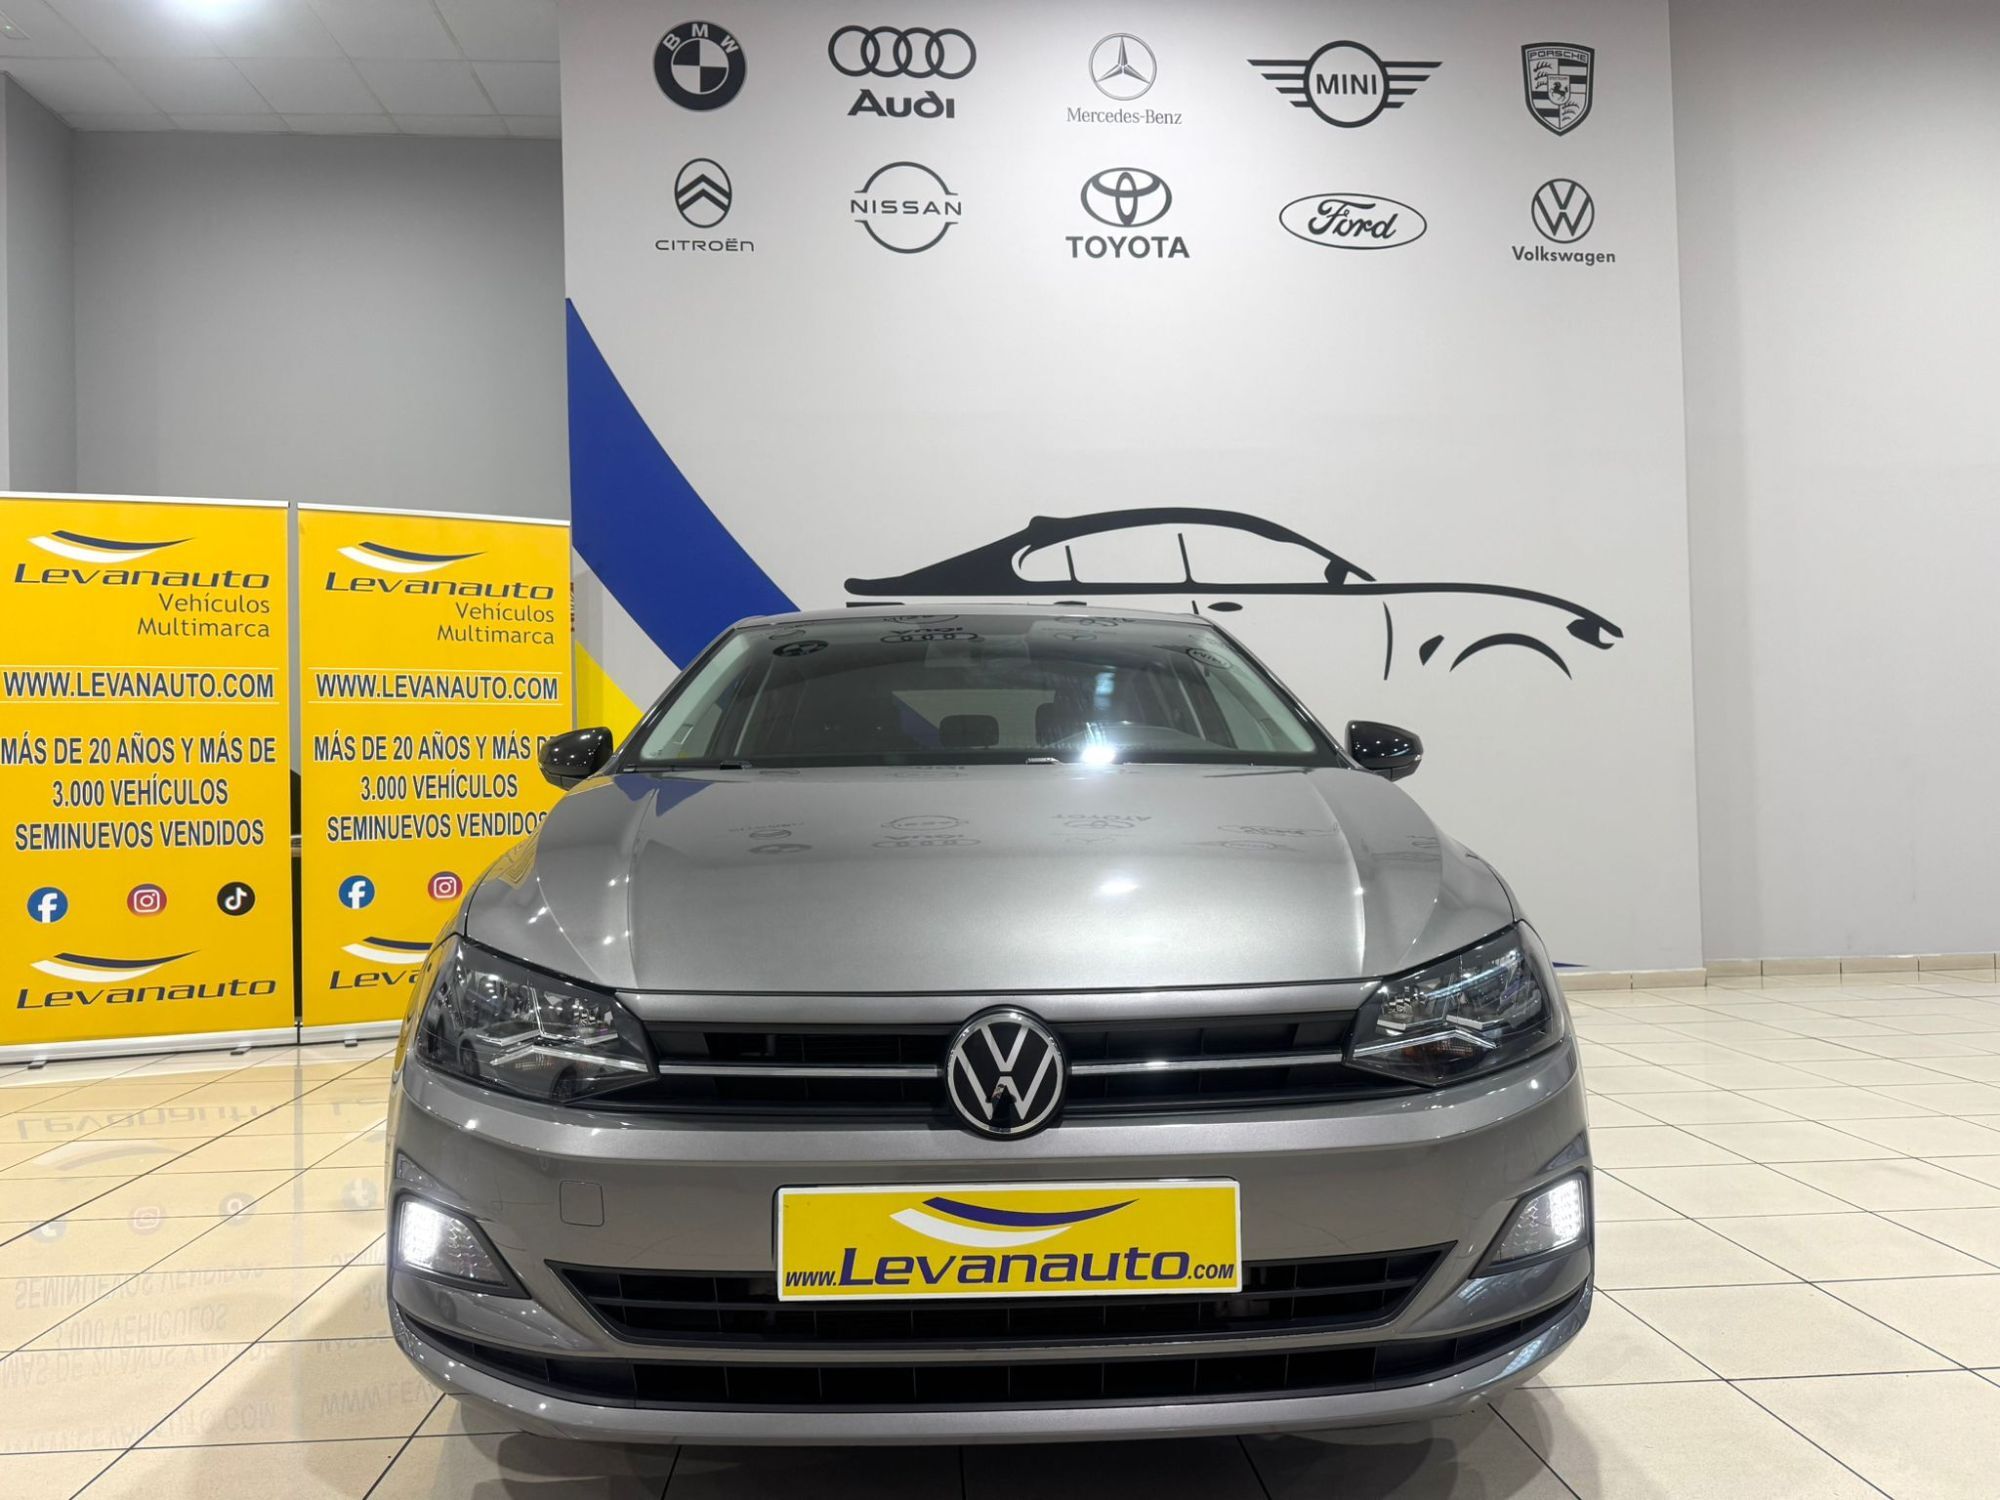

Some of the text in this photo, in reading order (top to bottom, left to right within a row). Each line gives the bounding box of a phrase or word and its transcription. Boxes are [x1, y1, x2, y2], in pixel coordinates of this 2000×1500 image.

[663, 23, 739, 54] BMW
[1529, 49, 1587, 62] PORSCHE
[1316, 73, 1377, 95] MINI
[847, 88, 955, 119] Audi
[1066, 107, 1183, 125] Mercedes-Benz
[850, 199, 962, 216] NISSAN
[1308, 198, 1399, 240] Ford
[1066, 235, 1190, 259] TOYOTA
[1511, 245, 1616, 266] Volkswagen
[14, 563, 270, 588] Levanauto
[325, 571, 555, 600] Levanauto
[158, 592, 270, 614] Vehículos
[455, 602, 555, 623] Vehículos
[137, 617, 270, 638] Multimarca
[436, 625, 555, 645] Multimarca
[4, 671, 274, 699] WWW.LEVANAUTO.COM
[316, 673, 558, 700] WWW.LEVANAUTO.COM
[0, 731, 276, 765] MÁS DE 20 AÑOS Y MÁS DE
[314, 729, 356, 761] MÁS
[362, 736, 387, 760] DE
[393, 736, 413, 760] 20
[418, 730, 471, 760] AÑOS
[475, 736, 487, 759] Y
[492, 730, 531, 759] MÁS
[52, 774, 229, 807] 3.000 VEHÍCULOS
[361, 769, 518, 801] 3.000 VEHÍCULOS
[15, 819, 264, 851] SEMINUEVOS VENDIDOS
[327, 813, 451, 842] SEMINUEVOS
[16, 978, 276, 1009] Levanauto
